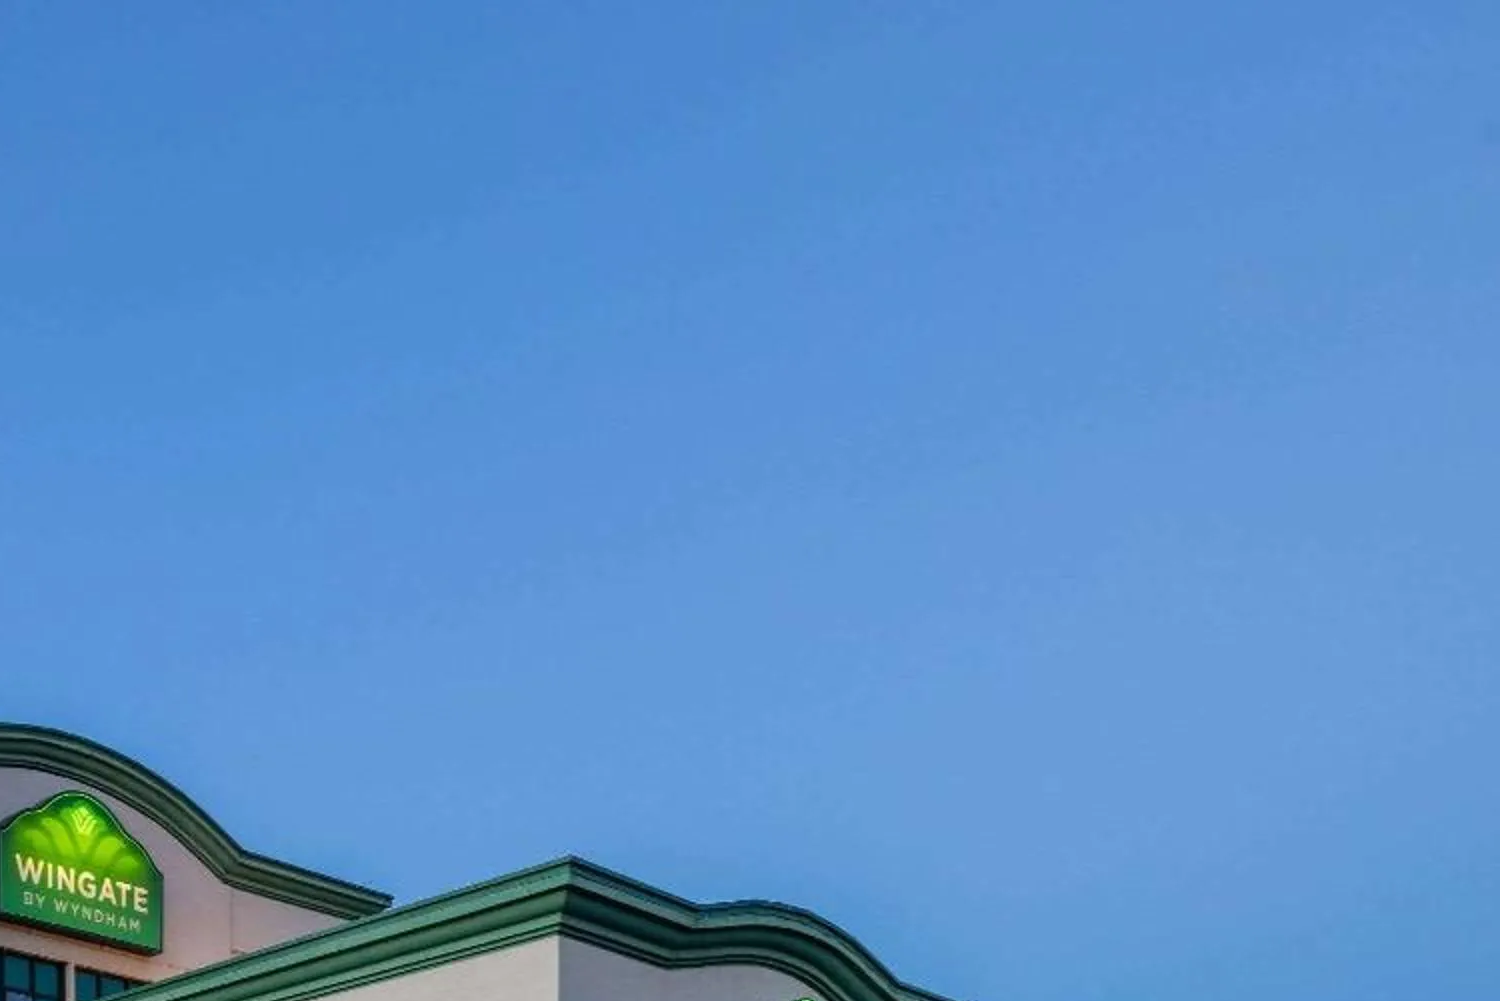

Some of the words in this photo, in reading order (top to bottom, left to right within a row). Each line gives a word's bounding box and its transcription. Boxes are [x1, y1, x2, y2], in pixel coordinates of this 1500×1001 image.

[15, 853, 149, 915] WINGATE
[23, 891, 45, 908] BY
[54, 898, 140, 932] WYNDHAM
